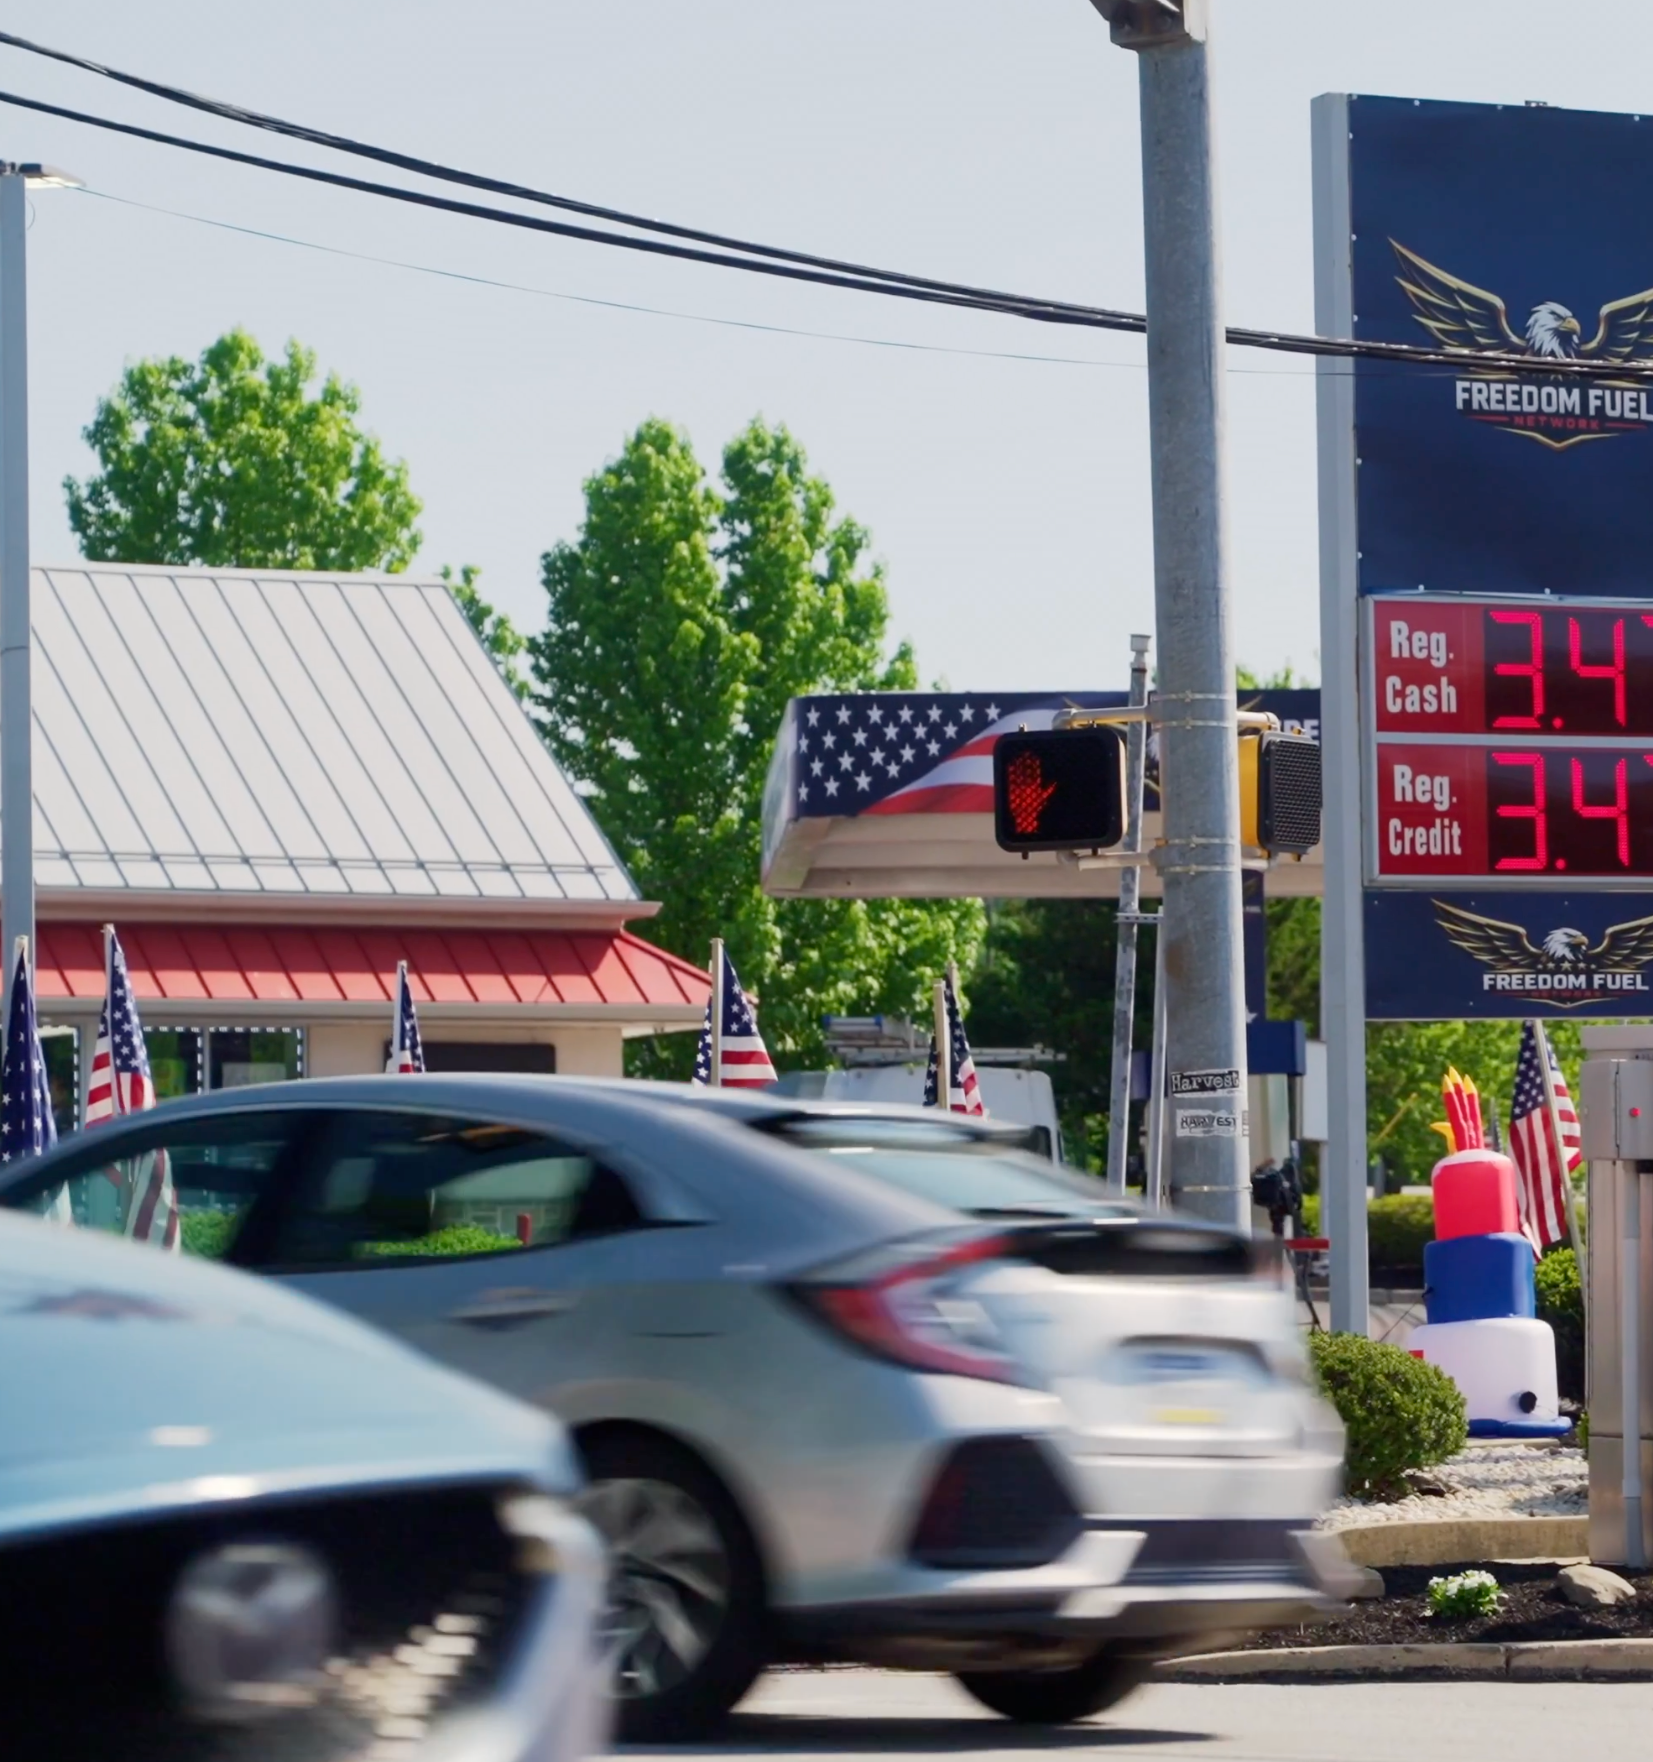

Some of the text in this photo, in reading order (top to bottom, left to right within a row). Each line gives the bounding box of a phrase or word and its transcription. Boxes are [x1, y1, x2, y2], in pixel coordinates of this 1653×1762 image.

[1455, 380, 1581, 416] FREEDOM
[1513, 416, 1600, 430] NETWORK
[1389, 620, 1454, 668] Reg.
[1385, 675, 1458, 714] Cash
[1393, 764, 1458, 812] Reg.
[1388, 818, 1462, 856] Credit
[1482, 973, 1650, 991] FREEDOM FUEL
[1171, 1072, 1240, 1092] Harvest
